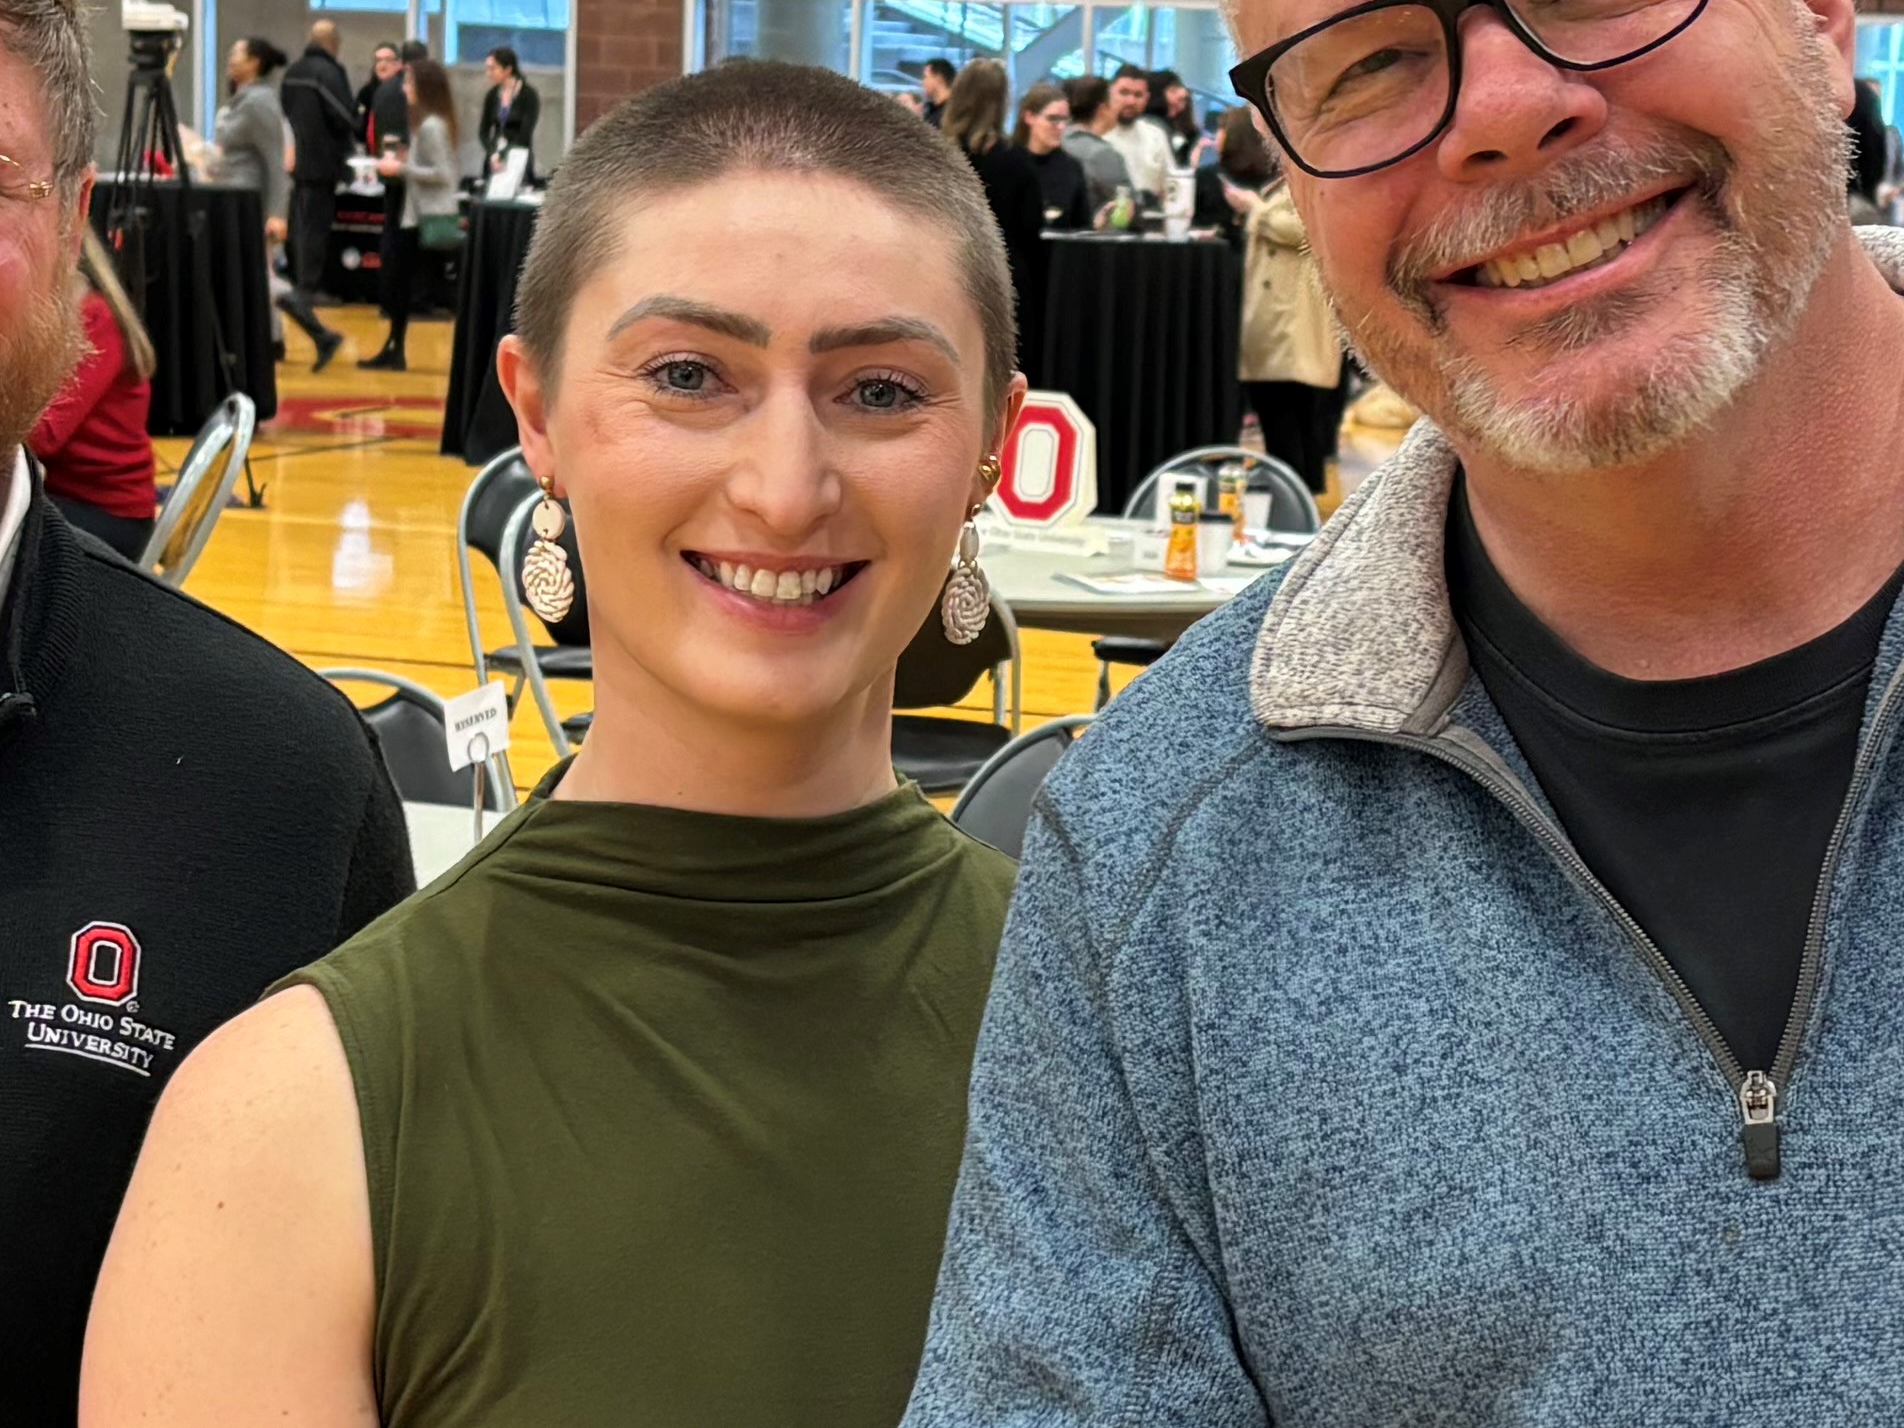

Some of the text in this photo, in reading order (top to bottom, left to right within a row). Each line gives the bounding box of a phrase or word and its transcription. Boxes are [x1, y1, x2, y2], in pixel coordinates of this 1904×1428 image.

[454, 707, 497, 733] RESERVED
[66, 921, 141, 1007] O
[8, 1000, 176, 1051] THE OHIO STATE
[27, 1021, 154, 1069] UNIVERSITY
